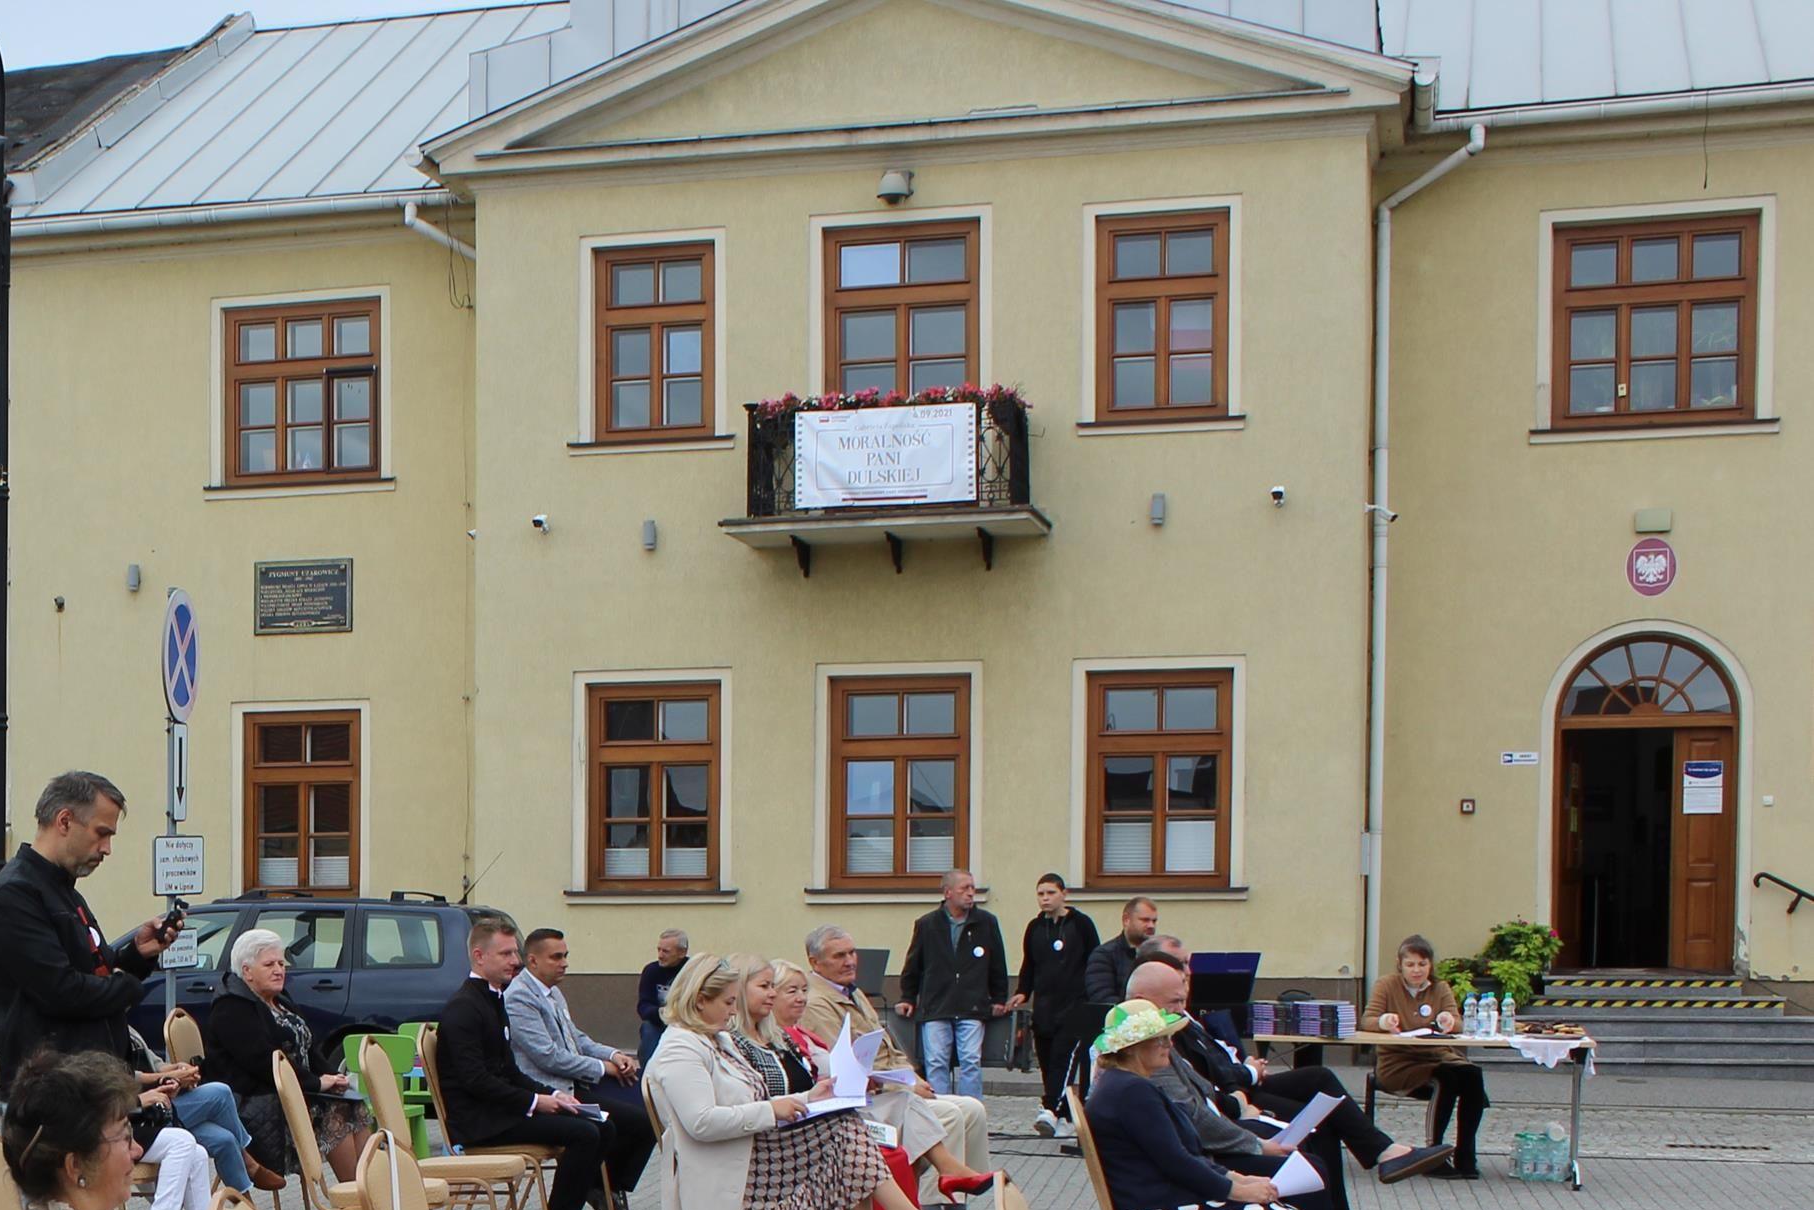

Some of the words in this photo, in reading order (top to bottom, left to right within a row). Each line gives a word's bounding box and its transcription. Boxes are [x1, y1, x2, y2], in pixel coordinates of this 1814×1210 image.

[838, 429, 931, 450] MORALNOŚĆ
[866, 452, 901, 466] PANI
[848, 468, 920, 485] DULSKIEJ
[165, 840, 174, 848] Nie
[176, 840, 193, 850] dotyczy
